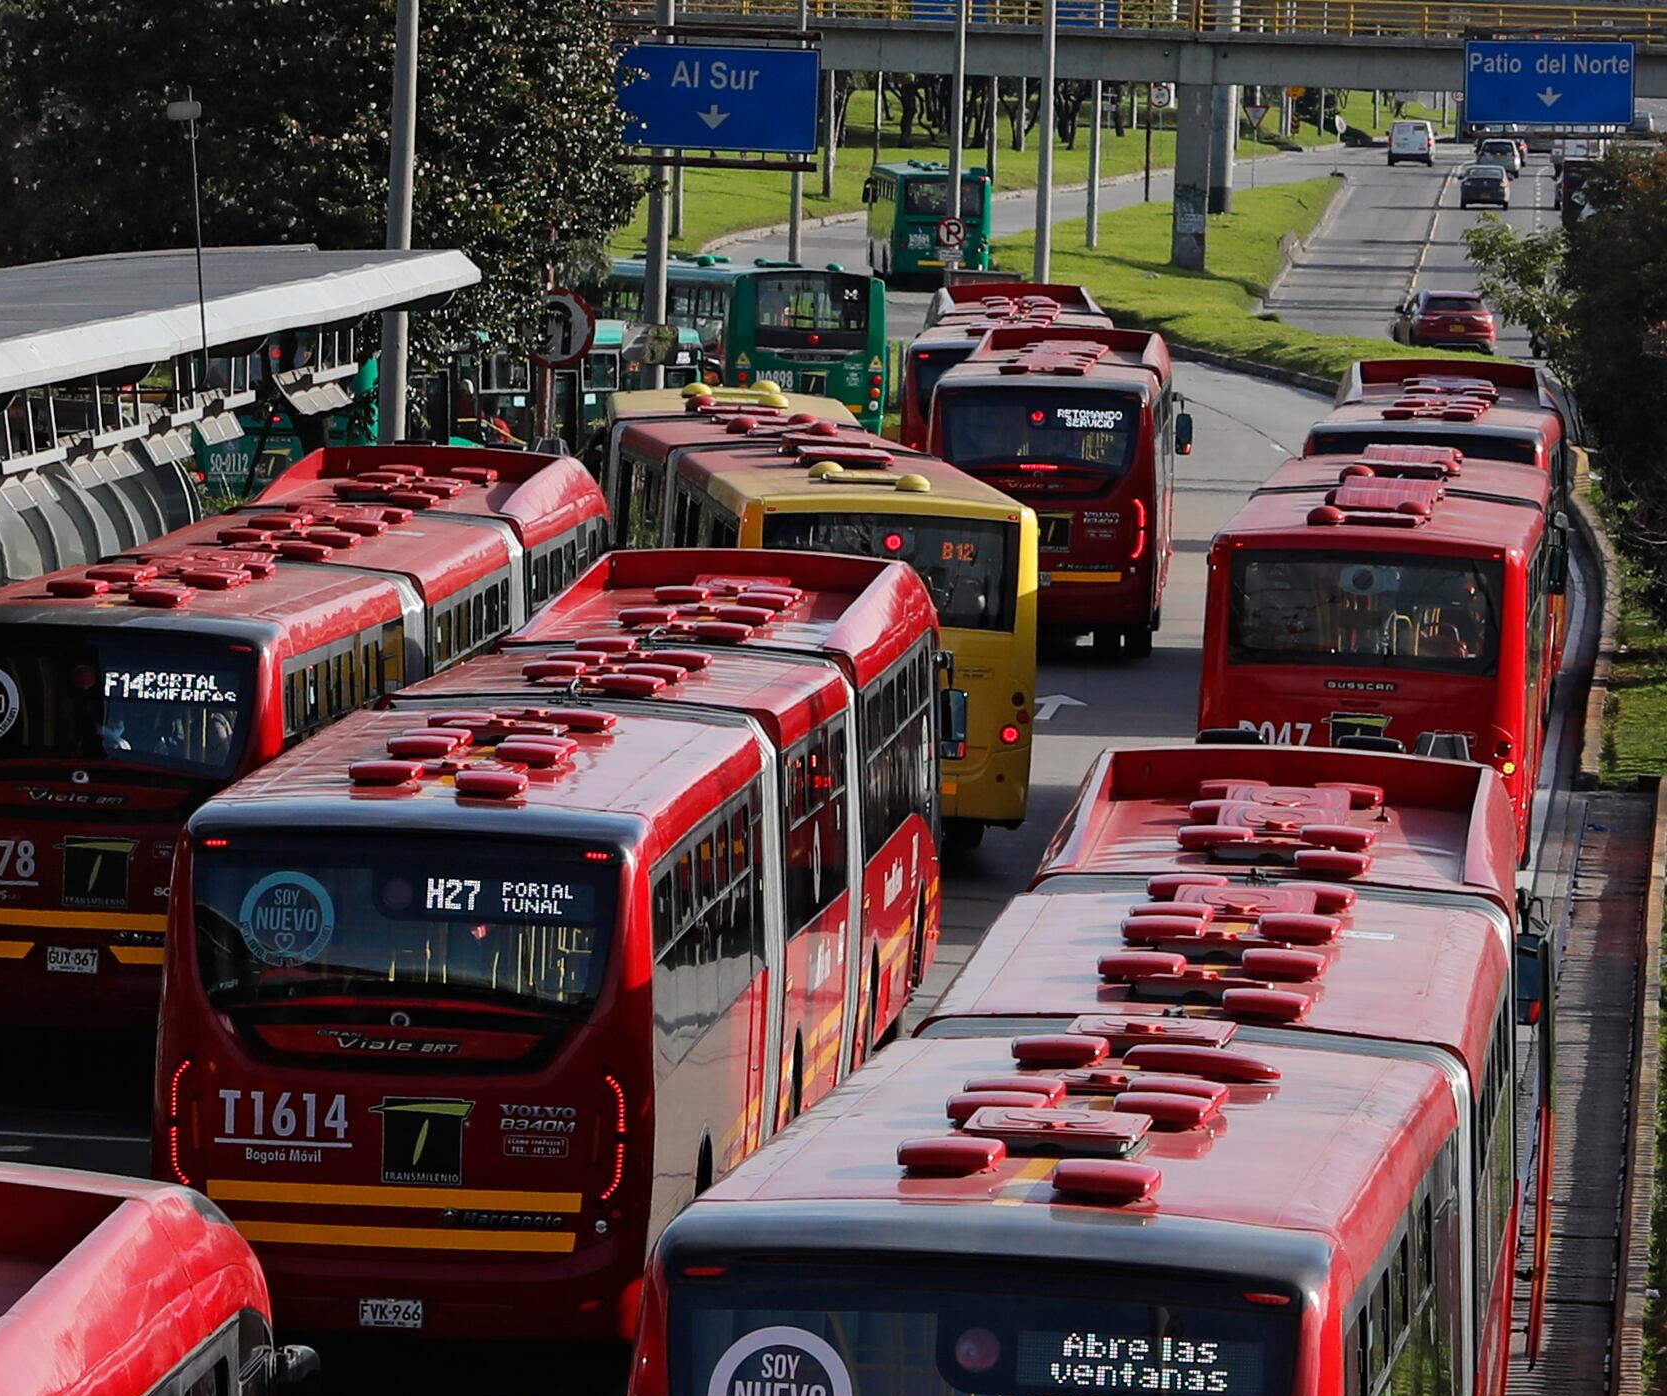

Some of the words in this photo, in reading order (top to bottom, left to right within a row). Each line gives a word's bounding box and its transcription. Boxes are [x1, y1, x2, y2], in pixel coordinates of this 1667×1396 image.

[1469, 52, 1522, 74] Patio
[1535, 54, 1566, 74] del
[1573, 54, 1630, 74] Norte
[670, 60, 699, 88] Al
[709, 61, 760, 90] Sur
[1057, 408, 1123, 421] RETOMANDO
[1065, 418, 1114, 429] SERVICIO
[104, 672, 144, 699] F14
[144, 671, 218, 690] PORTAL
[274, 888, 300, 906] SOY
[426, 877, 481, 911] H27
[501, 897, 564, 916] TUNAL
[255, 907, 317, 932] NUEVO
[336, 1036, 414, 1052] Viale
[218, 1089, 349, 1139] T1614
[499, 1104, 577, 1118] VOLVO
[499, 1118, 576, 1133] B340M
[245, 1147, 286, 1164] Bogotá
[289, 1147, 323, 1163] Móvil
[384, 1171, 460, 1183] TRANSMILENIO
[360, 1303, 421, 1321] FVK-966
[1062, 1332, 1150, 1361] Abre
[1162, 1336, 1218, 1364] las
[761, 1353, 800, 1379] SOY
[1050, 1362, 1229, 1392] ventanas
